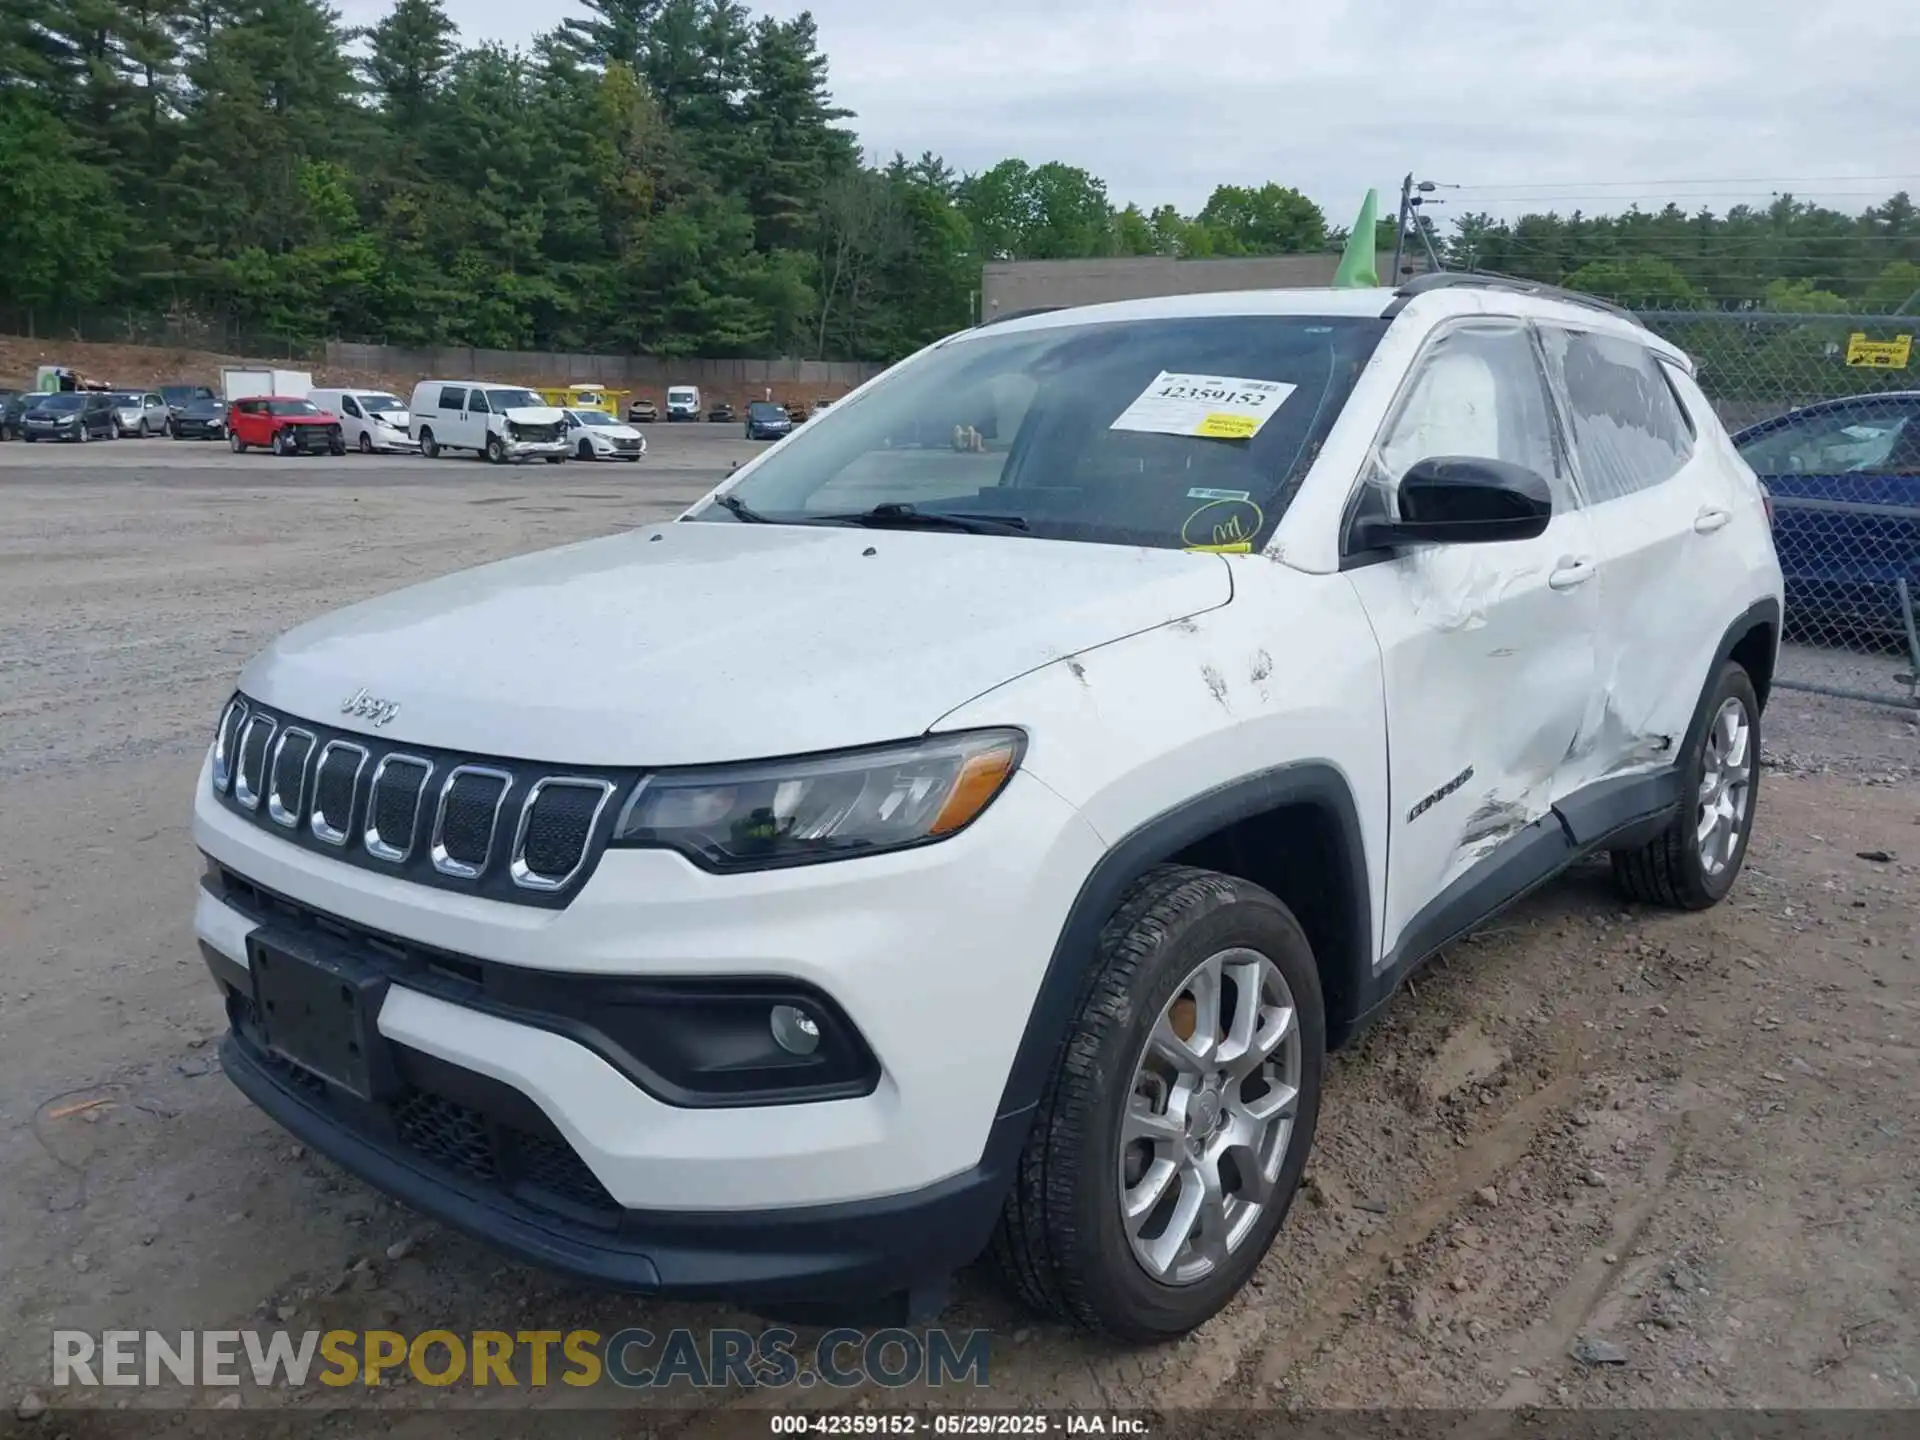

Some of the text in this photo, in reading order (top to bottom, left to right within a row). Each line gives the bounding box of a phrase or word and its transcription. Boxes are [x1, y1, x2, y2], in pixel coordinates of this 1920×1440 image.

[1158, 387, 1267, 406] 42359152
[341, 688, 400, 728] Jeep
[1407, 766, 1474, 824] COMPASS
